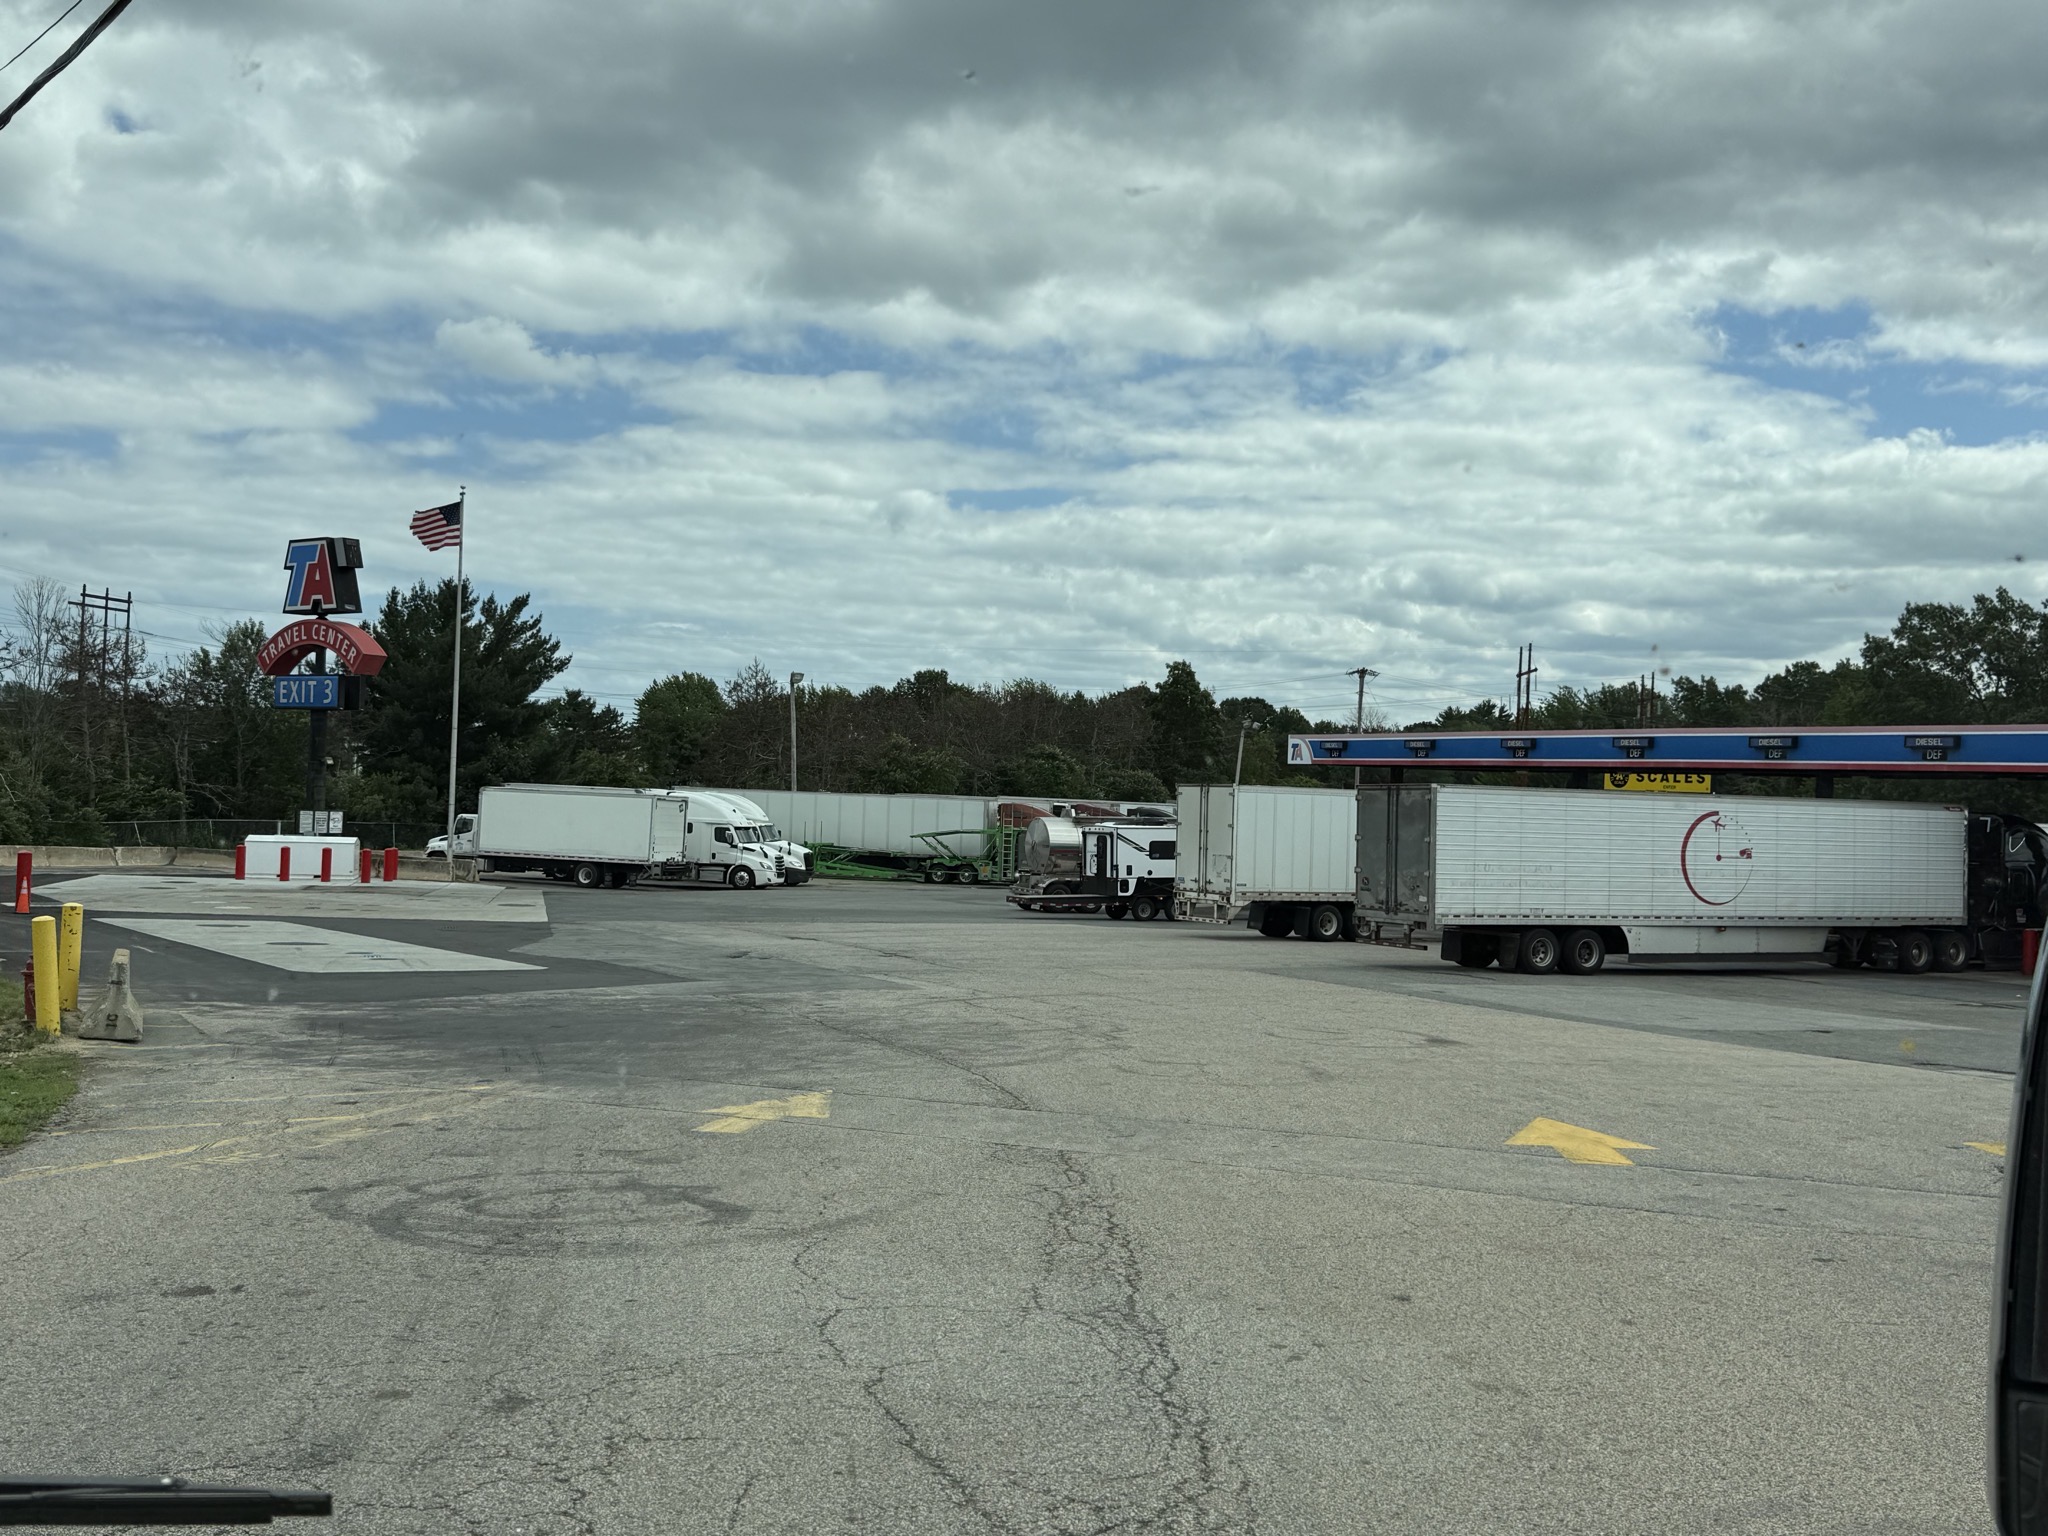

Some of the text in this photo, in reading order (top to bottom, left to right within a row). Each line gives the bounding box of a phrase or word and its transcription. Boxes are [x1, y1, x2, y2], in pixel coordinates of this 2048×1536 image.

[285, 540, 336, 610] TA
[262, 624, 357, 664] TRAVEL CENTER
[279, 679, 333, 704] EXIT 3
[1758, 738, 1783, 746] DIESEL
[1915, 738, 1943, 746] DIESEL
[1291, 743, 1304, 761] TA
[1417, 749, 1426, 757] DEF
[1515, 749, 1526, 757] DEF
[1629, 749, 1642, 758] DEF
[1768, 749, 1783, 759] DEF
[1926, 749, 1943, 760] DEF
[1636, 773, 1706, 784] SCALES
